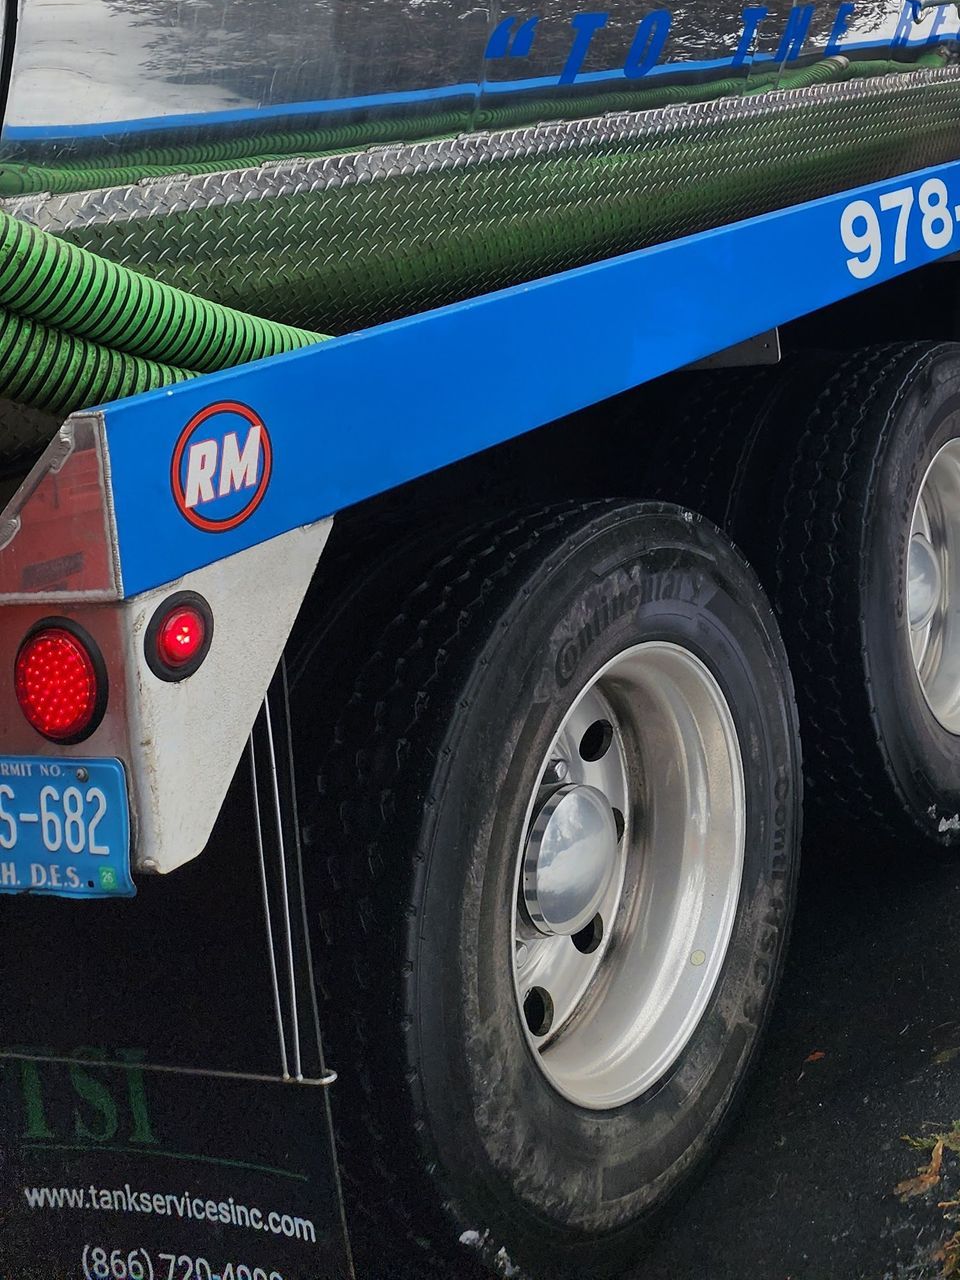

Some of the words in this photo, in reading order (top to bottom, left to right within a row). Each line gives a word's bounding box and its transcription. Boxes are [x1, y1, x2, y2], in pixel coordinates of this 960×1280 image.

[730, 2, 855, 67] THE
[185, 424, 262, 508] RM
[39, 763, 66, 778] NO.
[31, 863, 85, 889] D.E.S.
[24, 1183, 317, 1244] www.tankservicesinc.com
